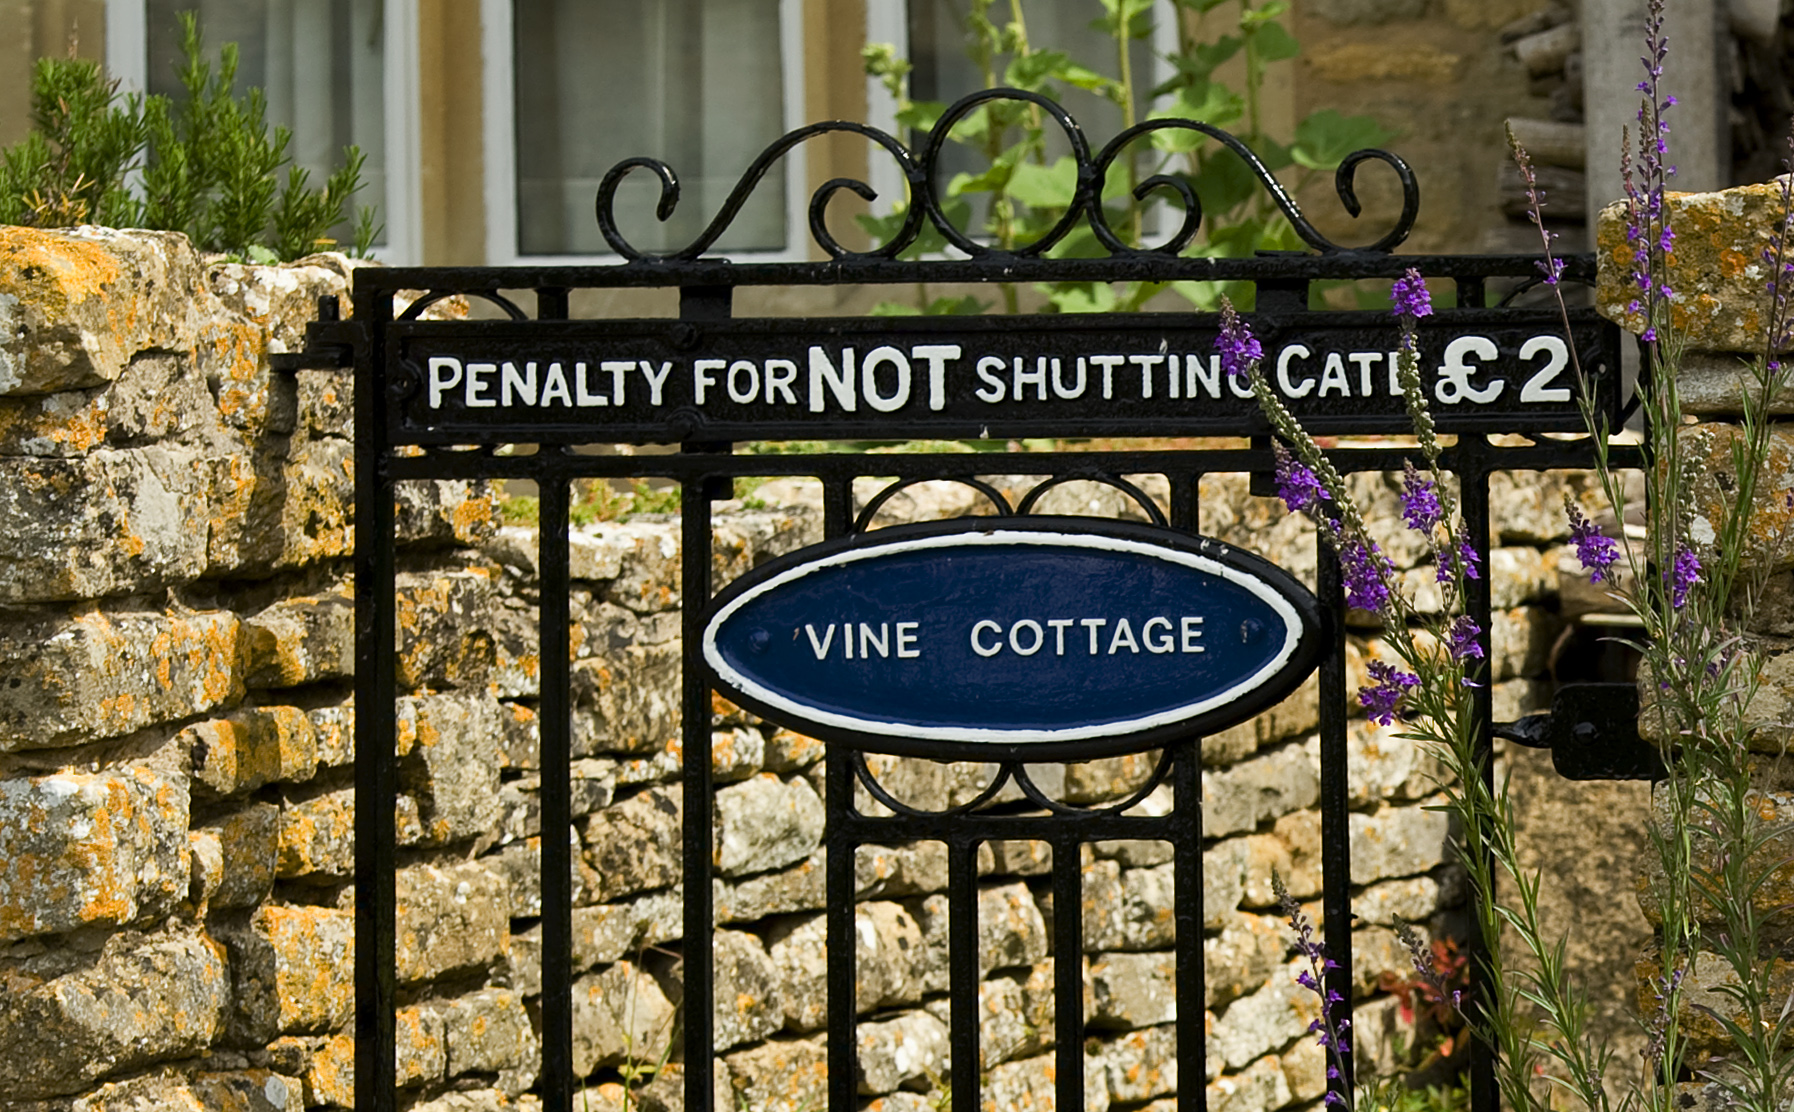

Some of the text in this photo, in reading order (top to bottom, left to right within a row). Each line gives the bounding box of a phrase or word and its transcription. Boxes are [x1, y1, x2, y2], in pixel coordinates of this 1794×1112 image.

[428, 357, 673, 408] PENALTY
[694, 359, 797, 404] FOR
[808, 345, 962, 412] NOT
[804, 616, 1205, 660] VINE COTTAGE
